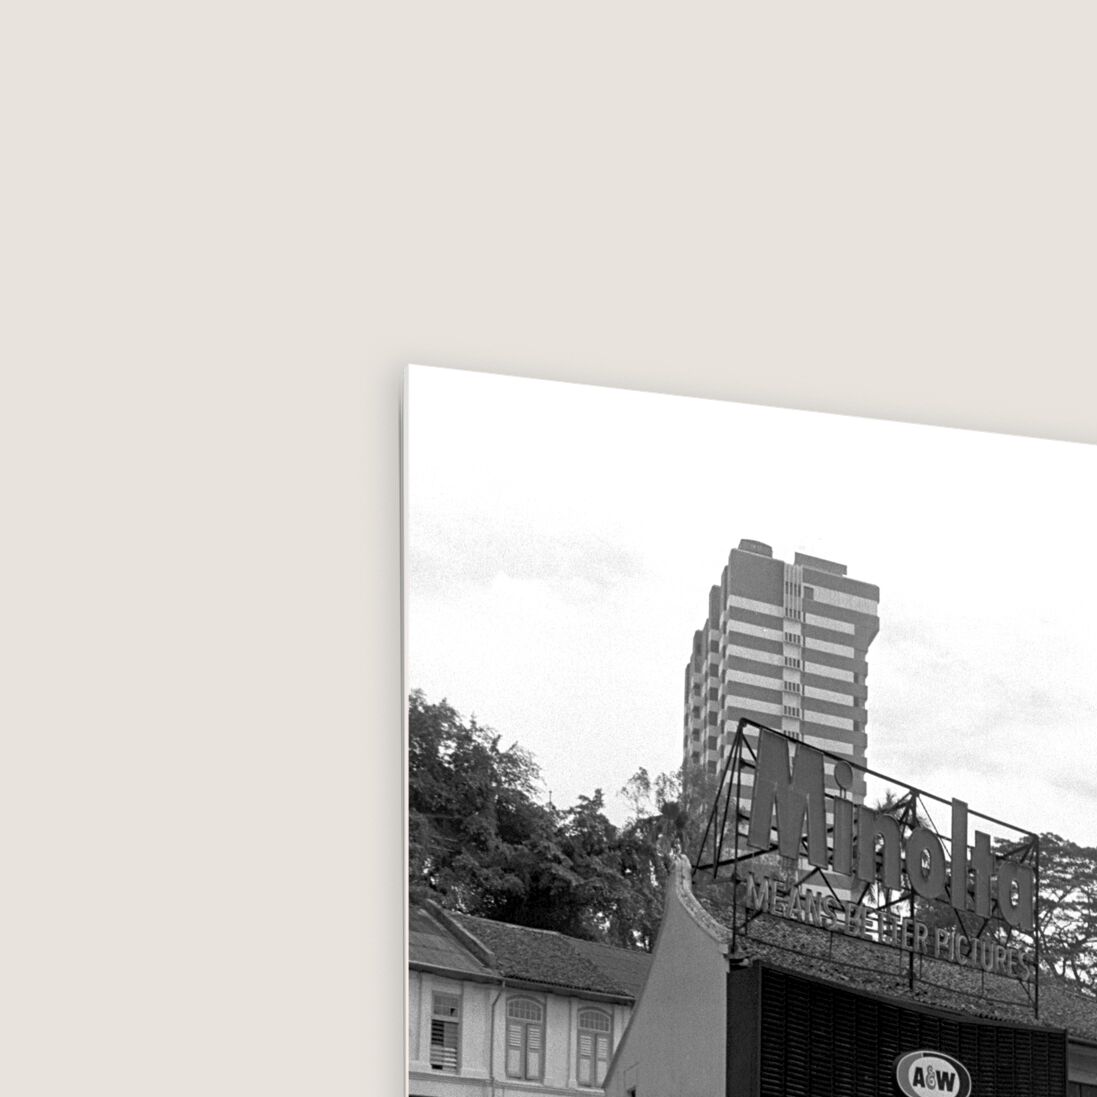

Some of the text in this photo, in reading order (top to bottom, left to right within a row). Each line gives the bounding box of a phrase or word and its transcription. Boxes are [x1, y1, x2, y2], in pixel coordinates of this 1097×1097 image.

[747, 728, 1034, 931] Minolta
[746, 873, 837, 930] MEANS
[934, 925, 1031, 981] PICTURES
[912, 1065, 955, 1092] A&W
